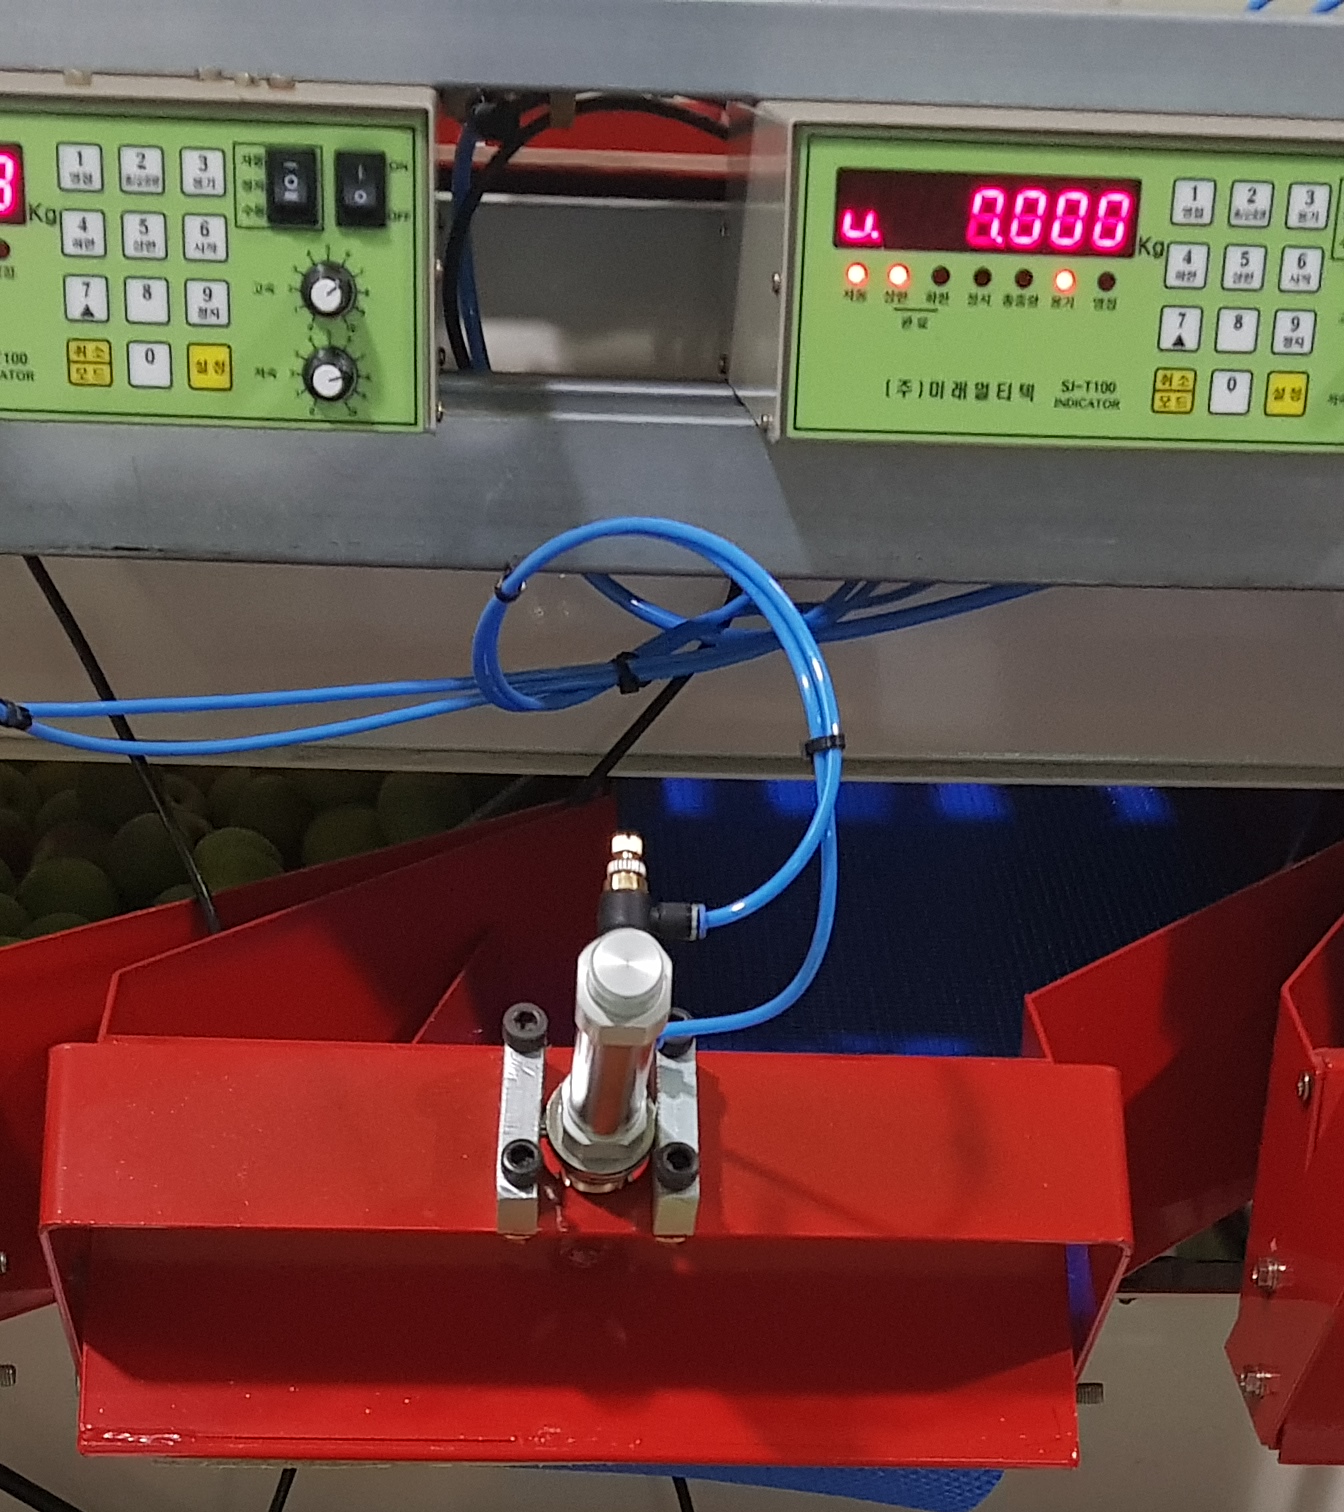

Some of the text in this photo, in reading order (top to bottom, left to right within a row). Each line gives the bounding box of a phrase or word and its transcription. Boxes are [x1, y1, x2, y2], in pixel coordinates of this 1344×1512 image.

[29, 203, 57, 225] Kg
[1139, 236, 1164, 259] Kg
[1061, 380, 1117, 394] SJ-T100
[1054, 397, 1120, 410] INDICATOR
